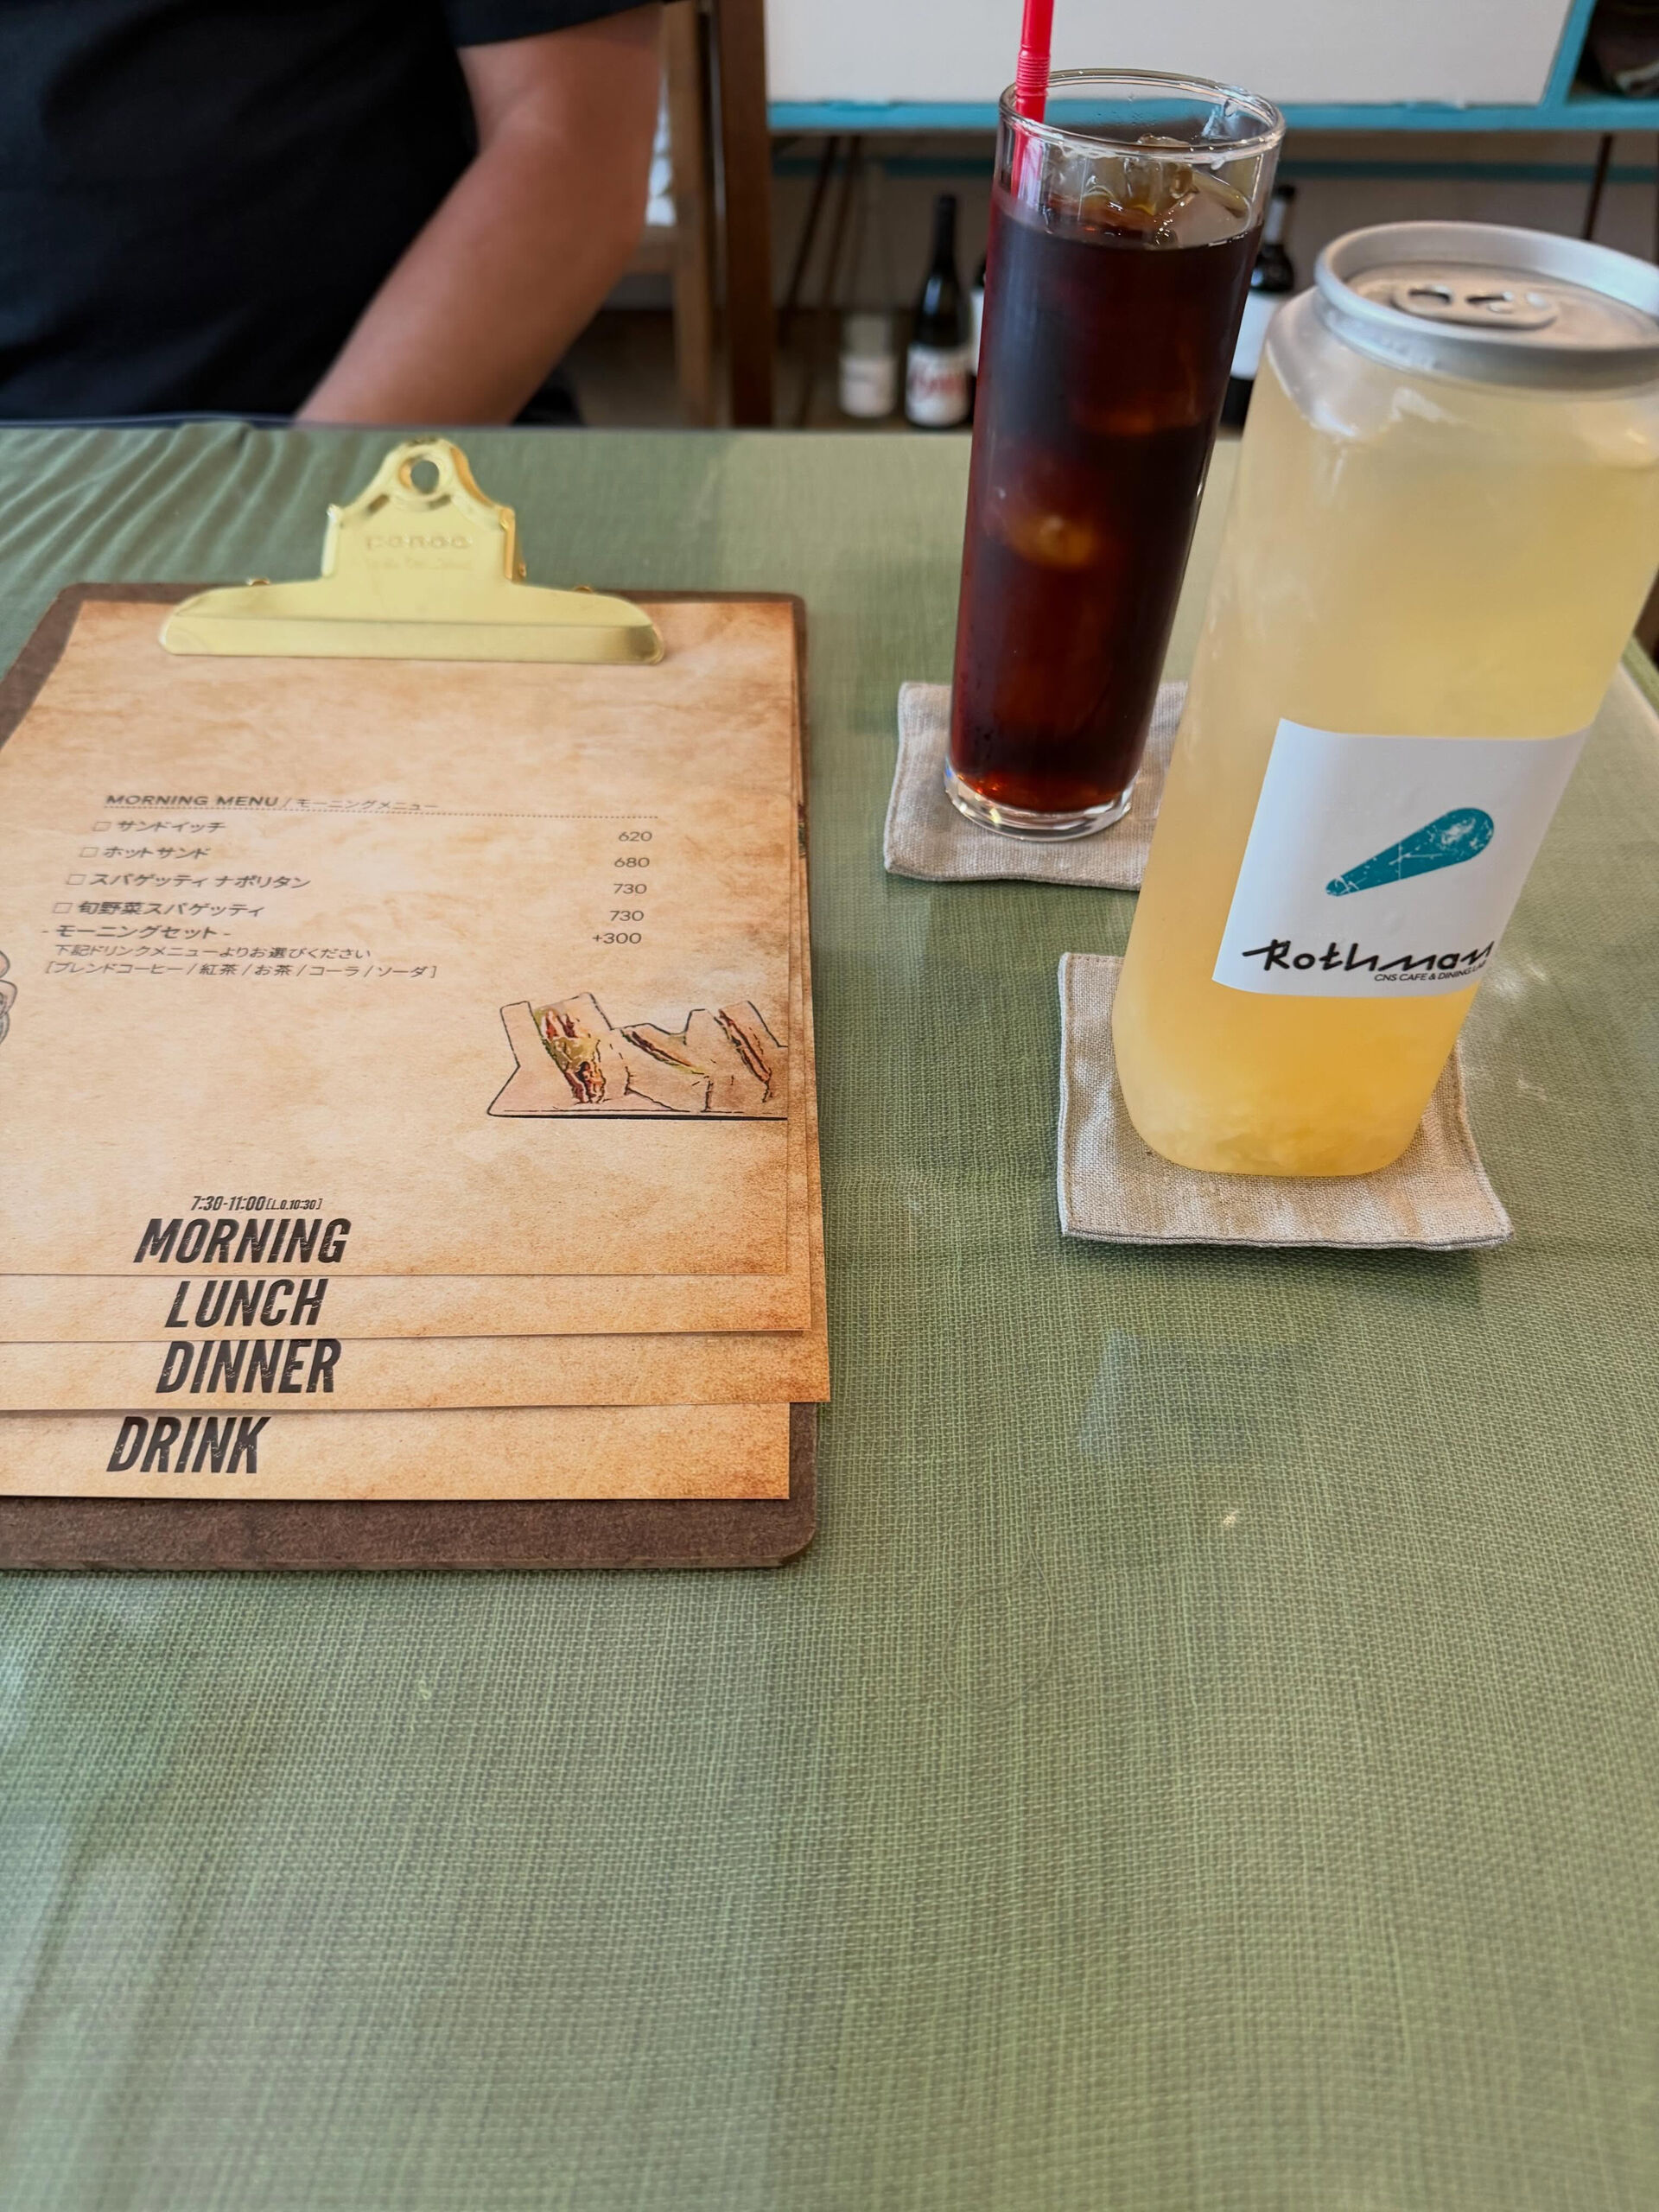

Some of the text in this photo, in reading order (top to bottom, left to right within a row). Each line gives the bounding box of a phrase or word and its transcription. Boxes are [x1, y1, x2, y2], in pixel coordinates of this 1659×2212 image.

[105, 795, 208, 806] MORNING
[216, 796, 279, 807] MENU
[296, 798, 439, 810] モーニングメニュー
[118, 820, 226, 834] サンドイッチ
[618, 830, 653, 842] 620
[103, 846, 211, 860] ホットサンド
[613, 857, 651, 868] 680
[613, 883, 647, 895] 730
[609, 910, 645, 922] 730
[592, 932, 642, 944] +300
[1374, 973, 1397, 982] CNS
[1399, 973, 1427, 982] CAFE
[133, 1217, 352, 1263] MORNING
[164, 1278, 329, 1327] LUNCH
[155, 1338, 342, 1394] DINNER
[105, 1415, 271, 1474] DRINK
